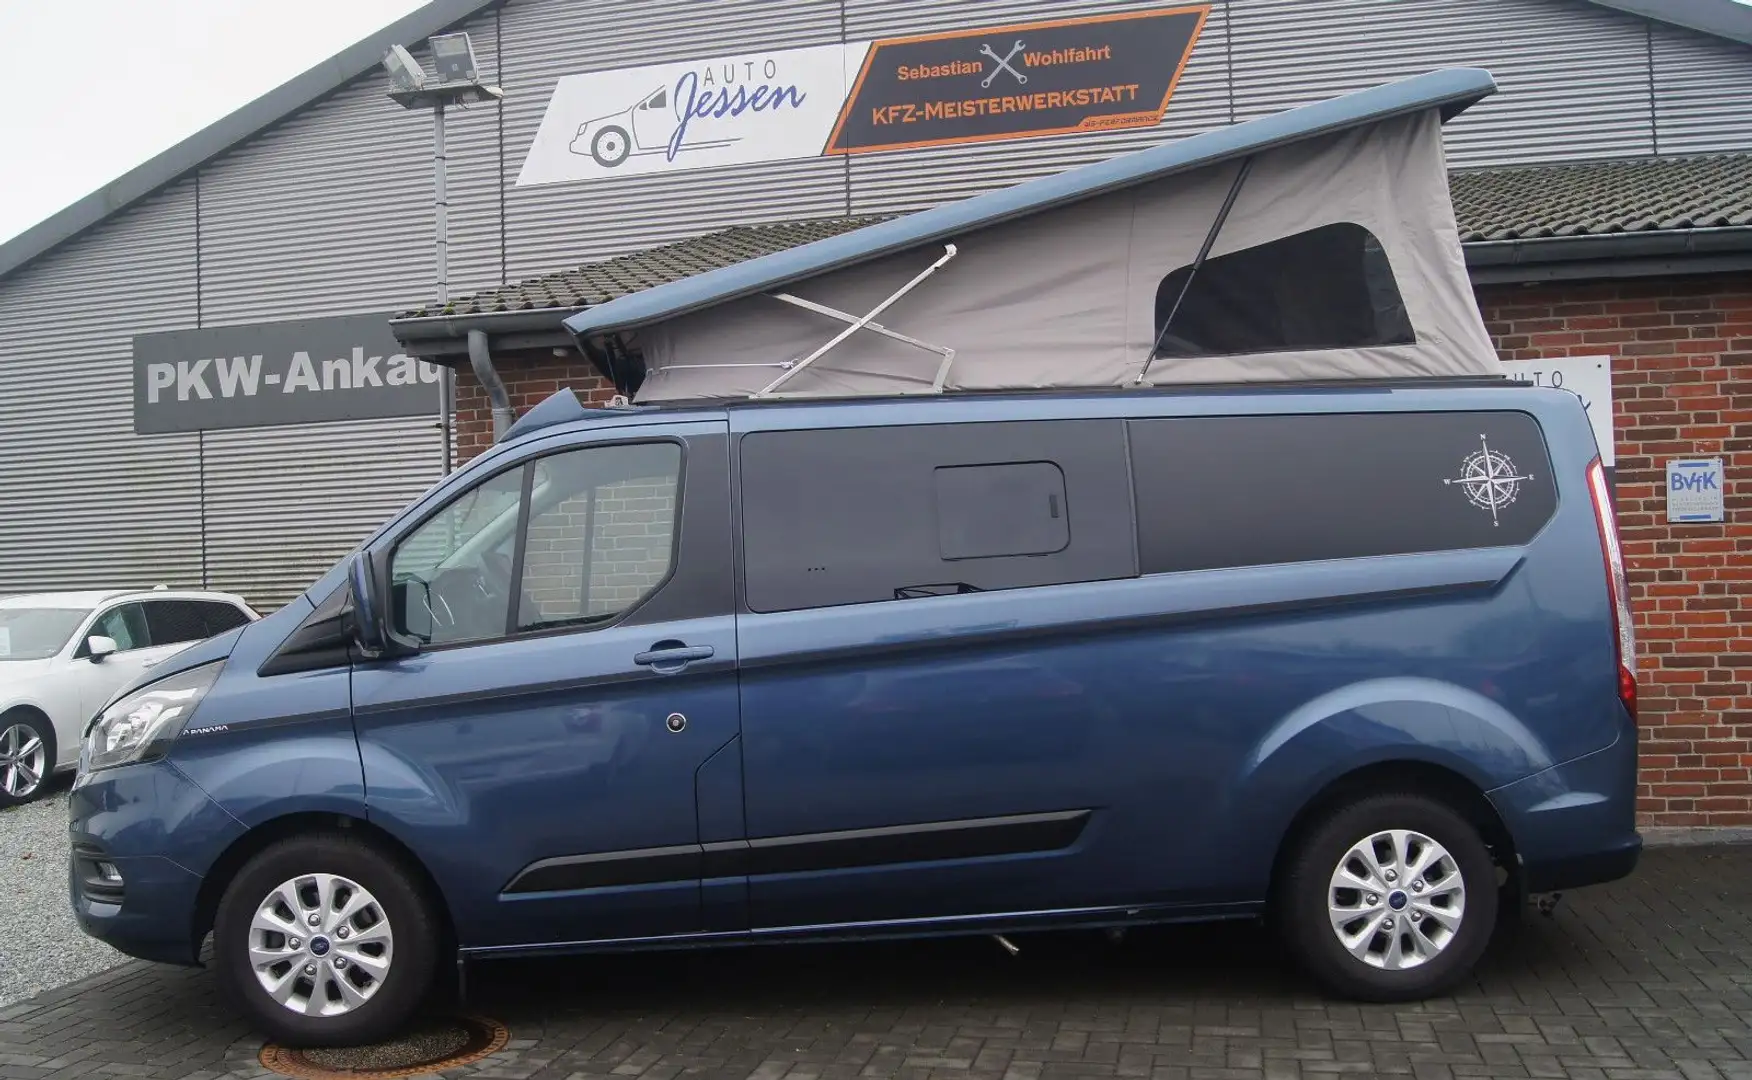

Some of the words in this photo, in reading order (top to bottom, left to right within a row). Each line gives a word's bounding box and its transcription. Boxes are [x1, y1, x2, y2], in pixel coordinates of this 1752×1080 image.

[704, 60, 776, 86] AUTO
[897, 60, 983, 80] Sebastian
[1023, 45, 1111, 67] Wohlfahrt
[667, 71, 806, 162] Jessen
[872, 84, 1139, 125] KFZ-MEISTERWERKSTATT
[147, 347, 441, 404] PKW-Ankau
[1671, 471, 1717, 493] BvfK
